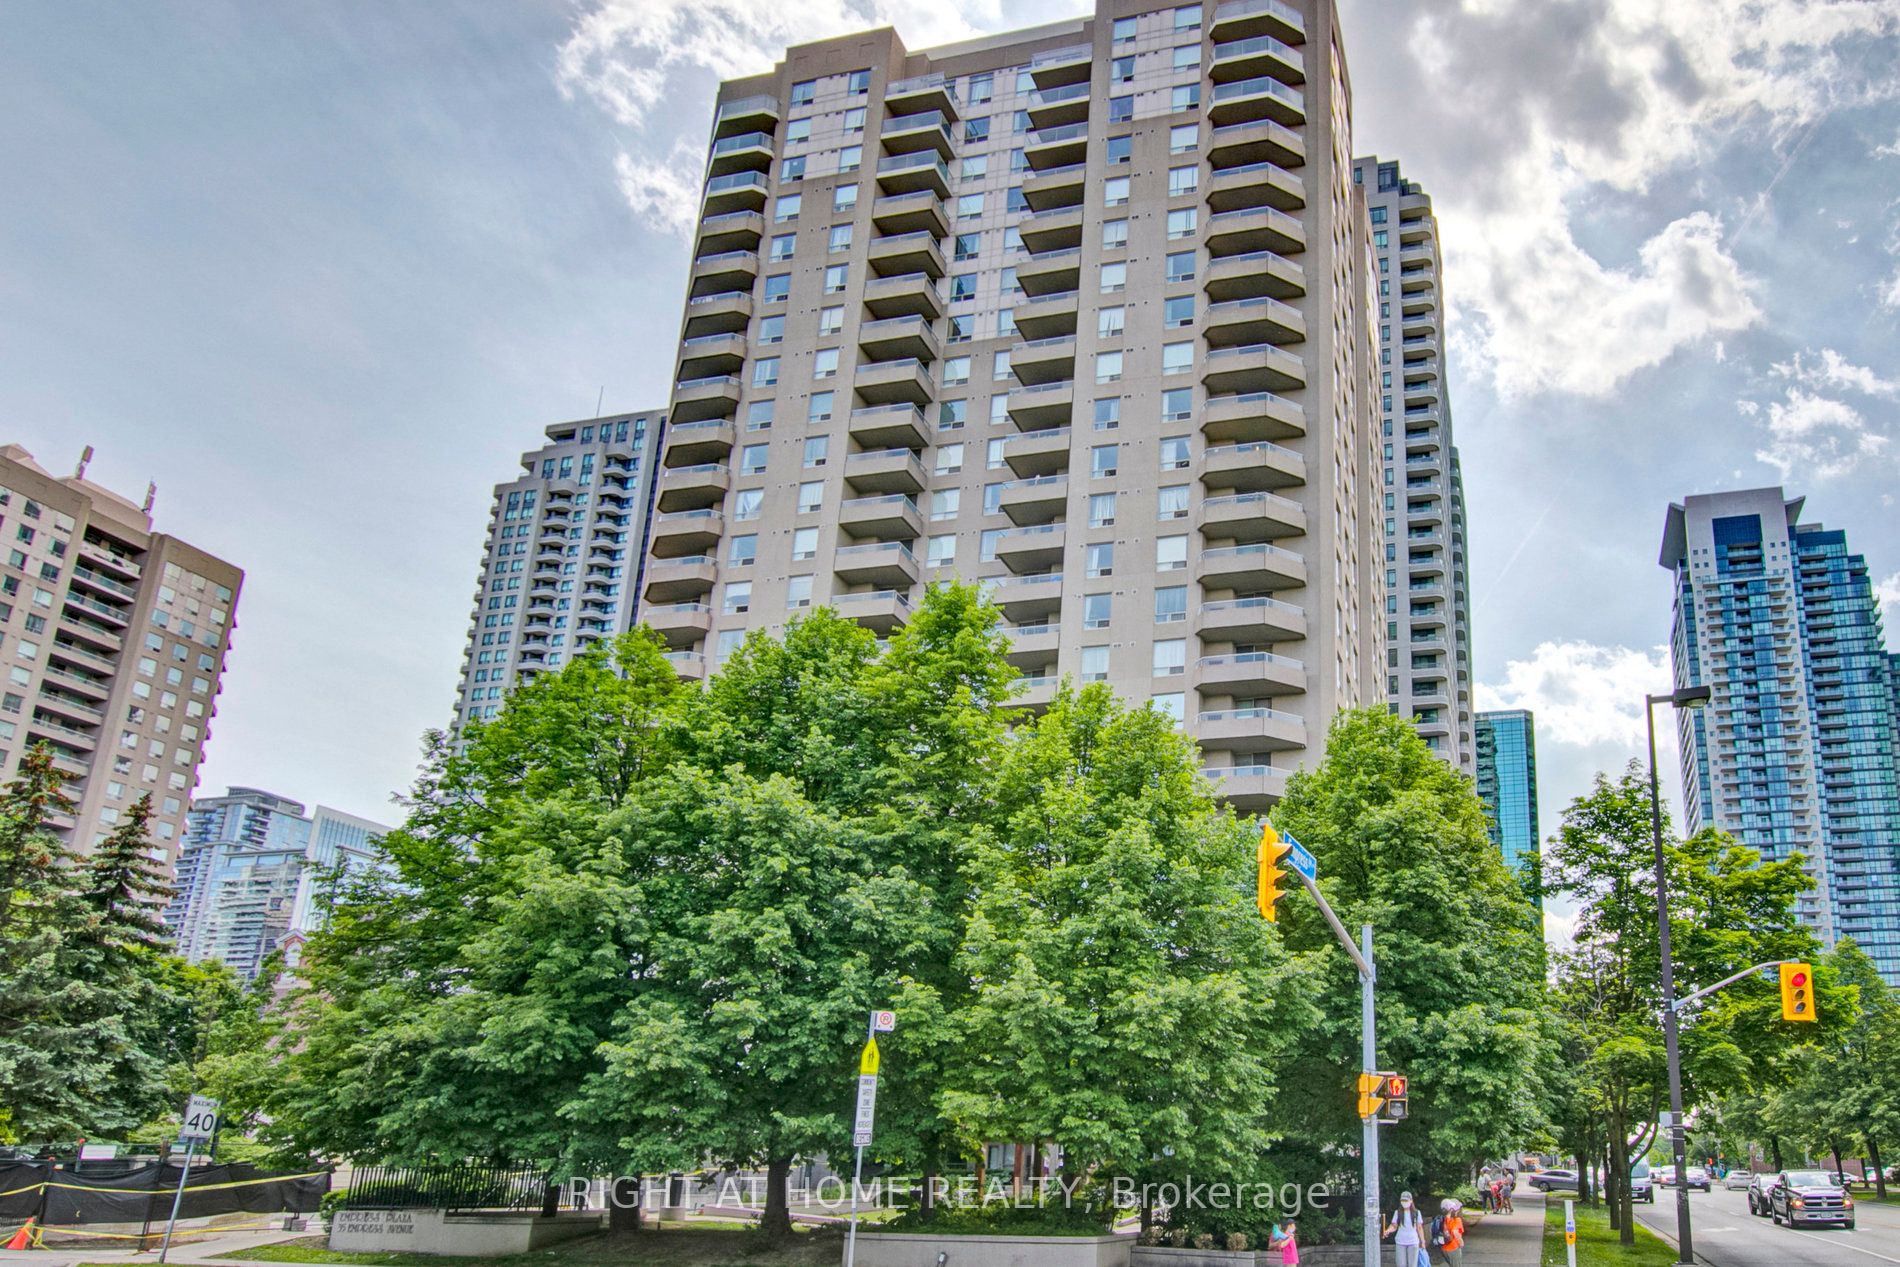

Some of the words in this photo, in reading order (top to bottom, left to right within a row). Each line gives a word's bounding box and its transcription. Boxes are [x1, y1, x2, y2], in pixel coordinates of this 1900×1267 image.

[188, 1113, 214, 1132] 40
[339, 1212, 380, 1222] EMPRESS
[386, 1212, 412, 1223] PLAZA
[347, 1224, 384, 1233] EMPRESS
[387, 1225, 414, 1234] AVENUE
